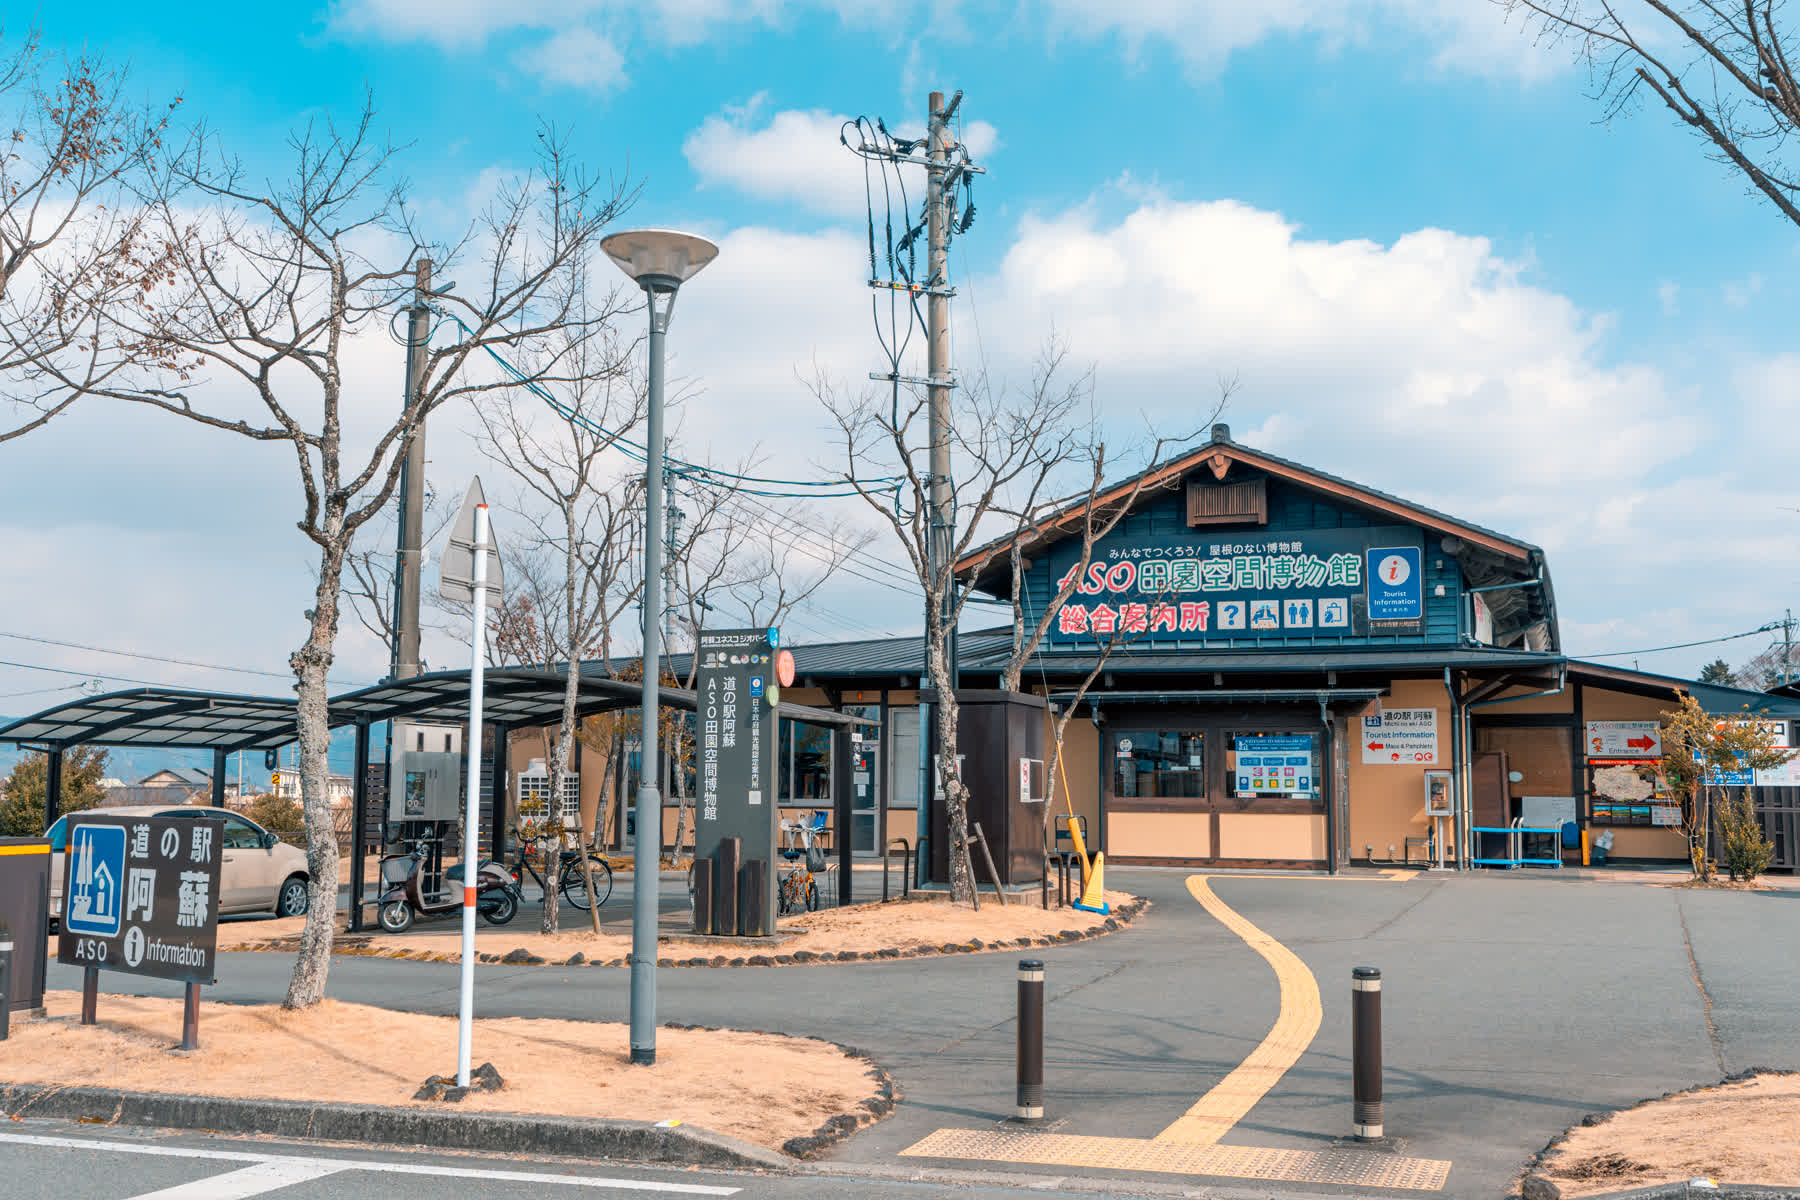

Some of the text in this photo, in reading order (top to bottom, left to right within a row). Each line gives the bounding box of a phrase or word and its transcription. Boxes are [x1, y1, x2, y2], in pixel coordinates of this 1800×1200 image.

[1209, 541, 1303, 556] 屋根のない博物館
[1057, 554, 1361, 594] ASO田園空間博物館
[1058, 601, 1210, 634] 総合案内所
[722, 676, 736, 748] 道の駅阿蘇
[1384, 711, 1432, 720] 道の駅 阿蘇
[704, 677, 718, 820] ASO田園空間博物館
[1365, 731, 1435, 739] Tourist Information
[272, 774, 280, 784] 2
[130, 823, 213, 864] 道の駅
[126, 868, 210, 928] 阿蘇
[75, 938, 108, 962] ASO
[147, 937, 206, 967] Information
